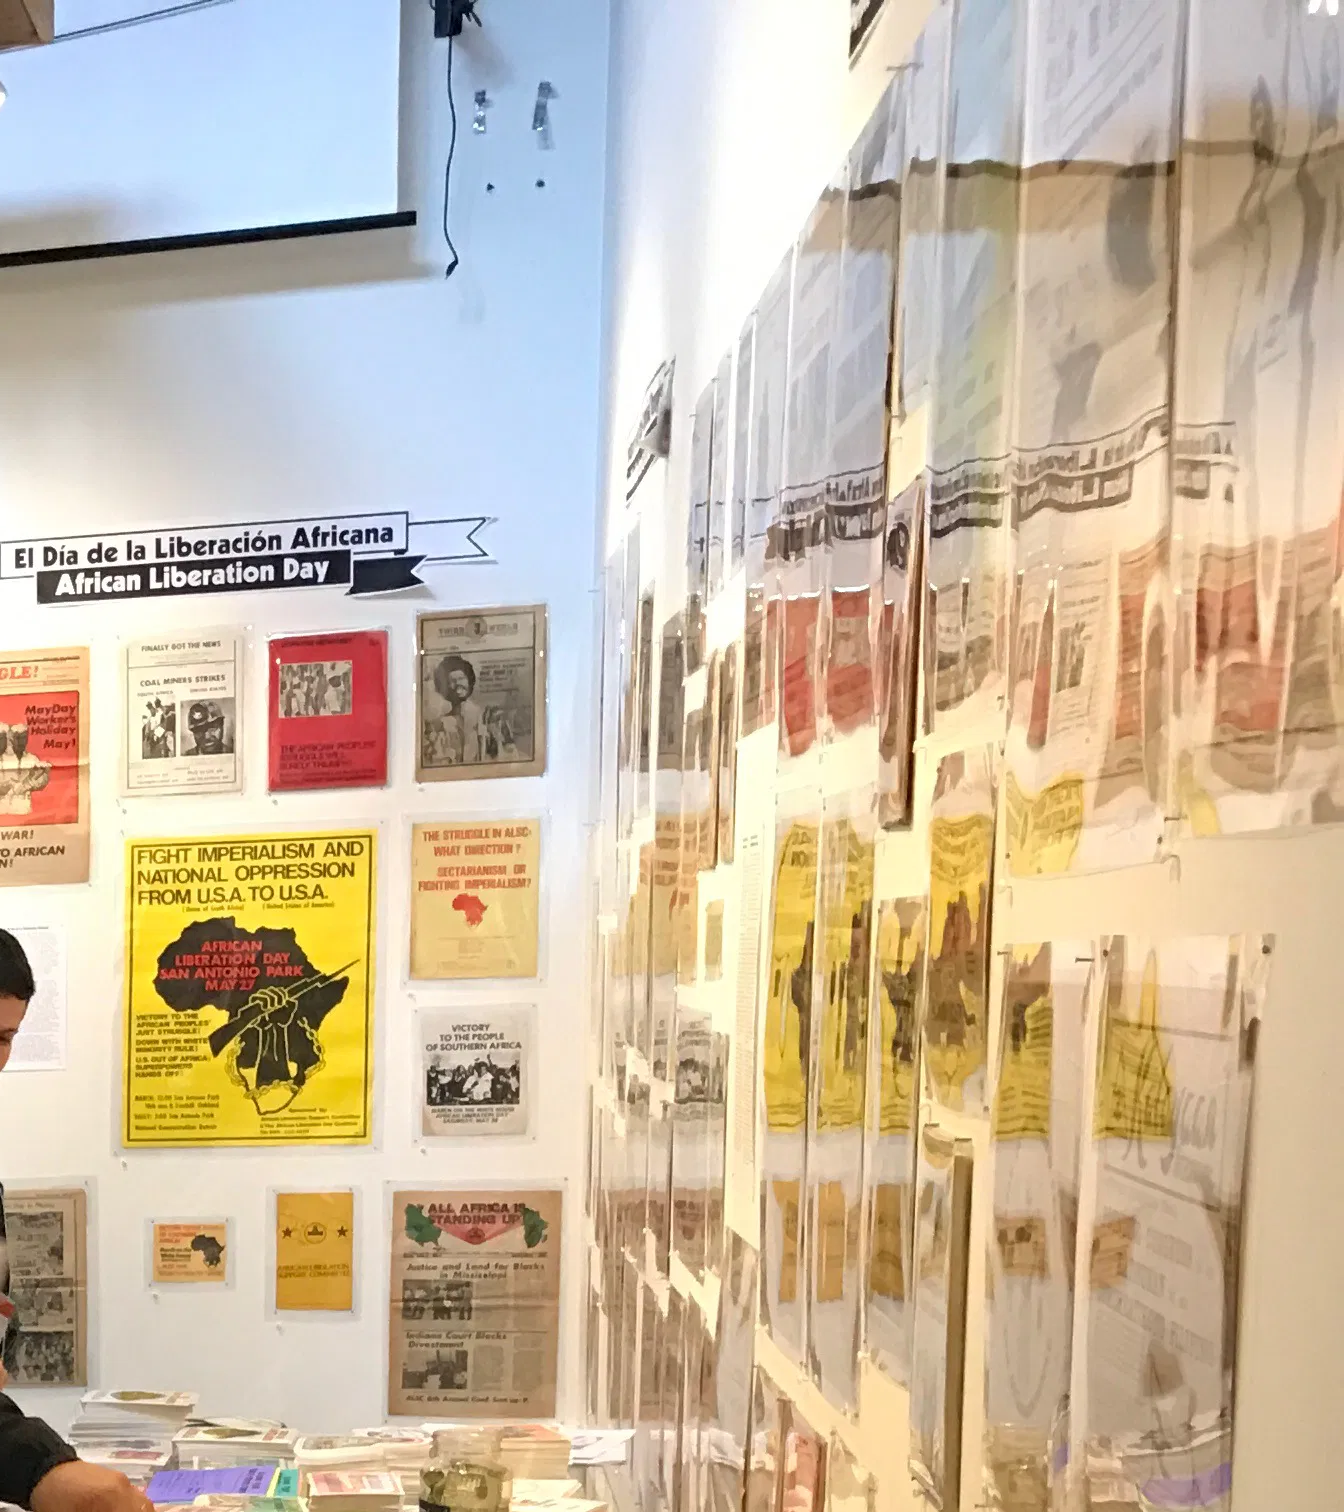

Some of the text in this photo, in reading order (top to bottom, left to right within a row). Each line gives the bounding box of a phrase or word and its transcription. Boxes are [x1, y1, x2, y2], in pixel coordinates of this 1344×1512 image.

[14, 524, 394, 569] El Día de la Liberación Africana
[54, 558, 330, 596] African Liberation Day
[1, 830, 34, 840] WAR!
[423, 831, 440, 842] THE
[492, 828, 502, 838] IN
[14, 845, 66, 857] AFRICAN
[137, 840, 364, 865] FIGHT IMPERIALISM AND
[433, 845, 461, 857] WHAT
[137, 862, 355, 886] NATIONAL OPPRESSION
[437, 865, 507, 877] SECTARIANISM
[137, 889, 192, 906] FROM
[248, 886, 275, 902] TO
[201, 941, 262, 952] AFRICAN
[175, 953, 290, 966] LIBERATION DAY
[160, 966, 304, 979] SAN ANTONIO PARK
[205, 979, 256, 990] MAY 27
[452, 1024, 490, 1032] VICTORY
[439, 1032, 504, 1042] TO THE PEOPLE
[440, 1042, 487, 1051] SOUTHERN
[489, 1042, 522, 1050] AFRICA
[428, 1203, 455, 1214] ALL
[460, 1203, 510, 1213] AFRICA
